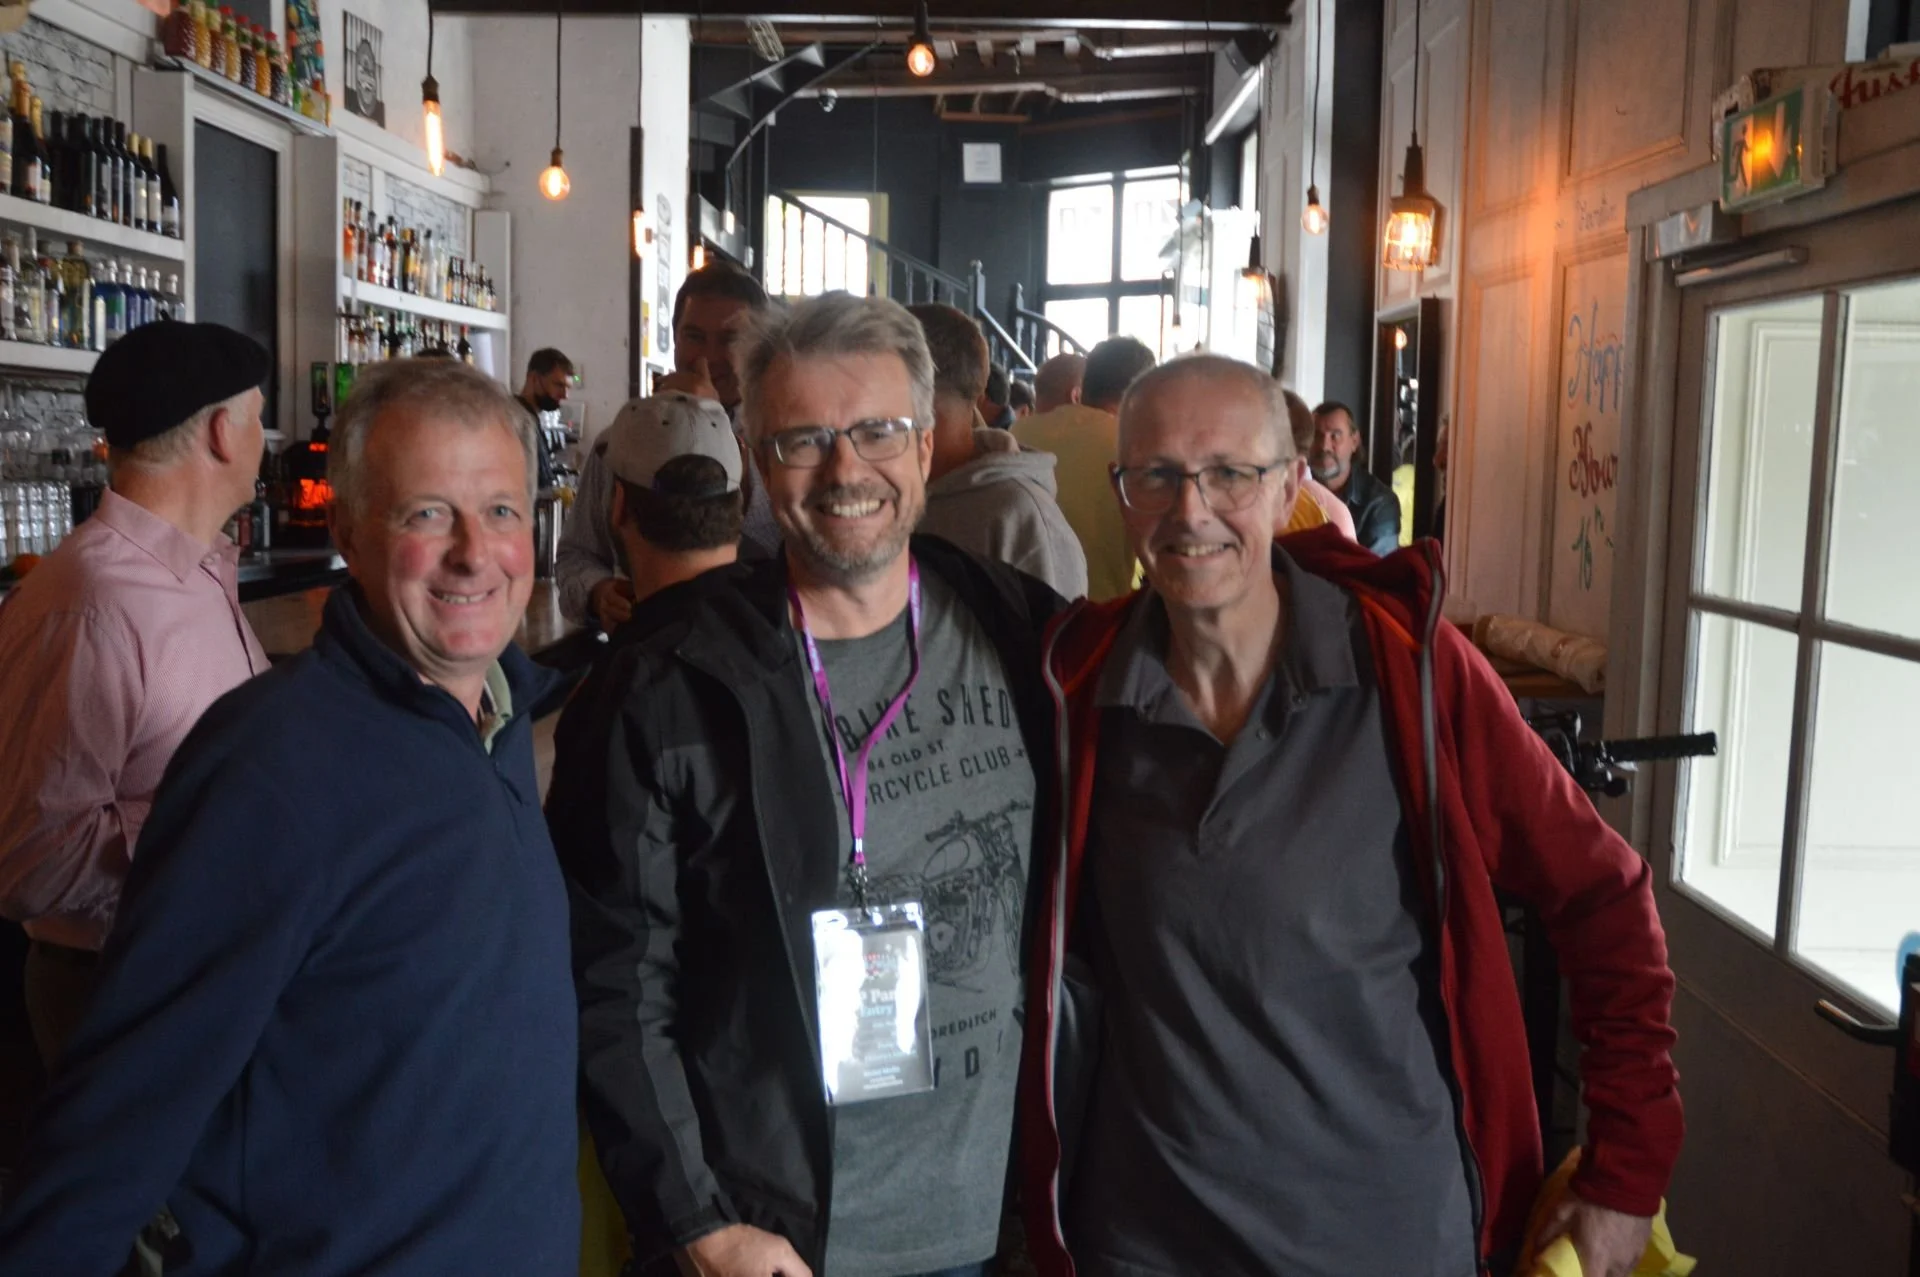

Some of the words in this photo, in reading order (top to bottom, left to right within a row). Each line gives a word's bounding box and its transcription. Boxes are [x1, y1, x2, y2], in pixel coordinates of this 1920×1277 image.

[937, 683, 1011, 729] SHED
[869, 764, 952, 804] RCYCLE
[960, 746, 1011, 778] CLUB
[891, 749, 921, 766] OLD
